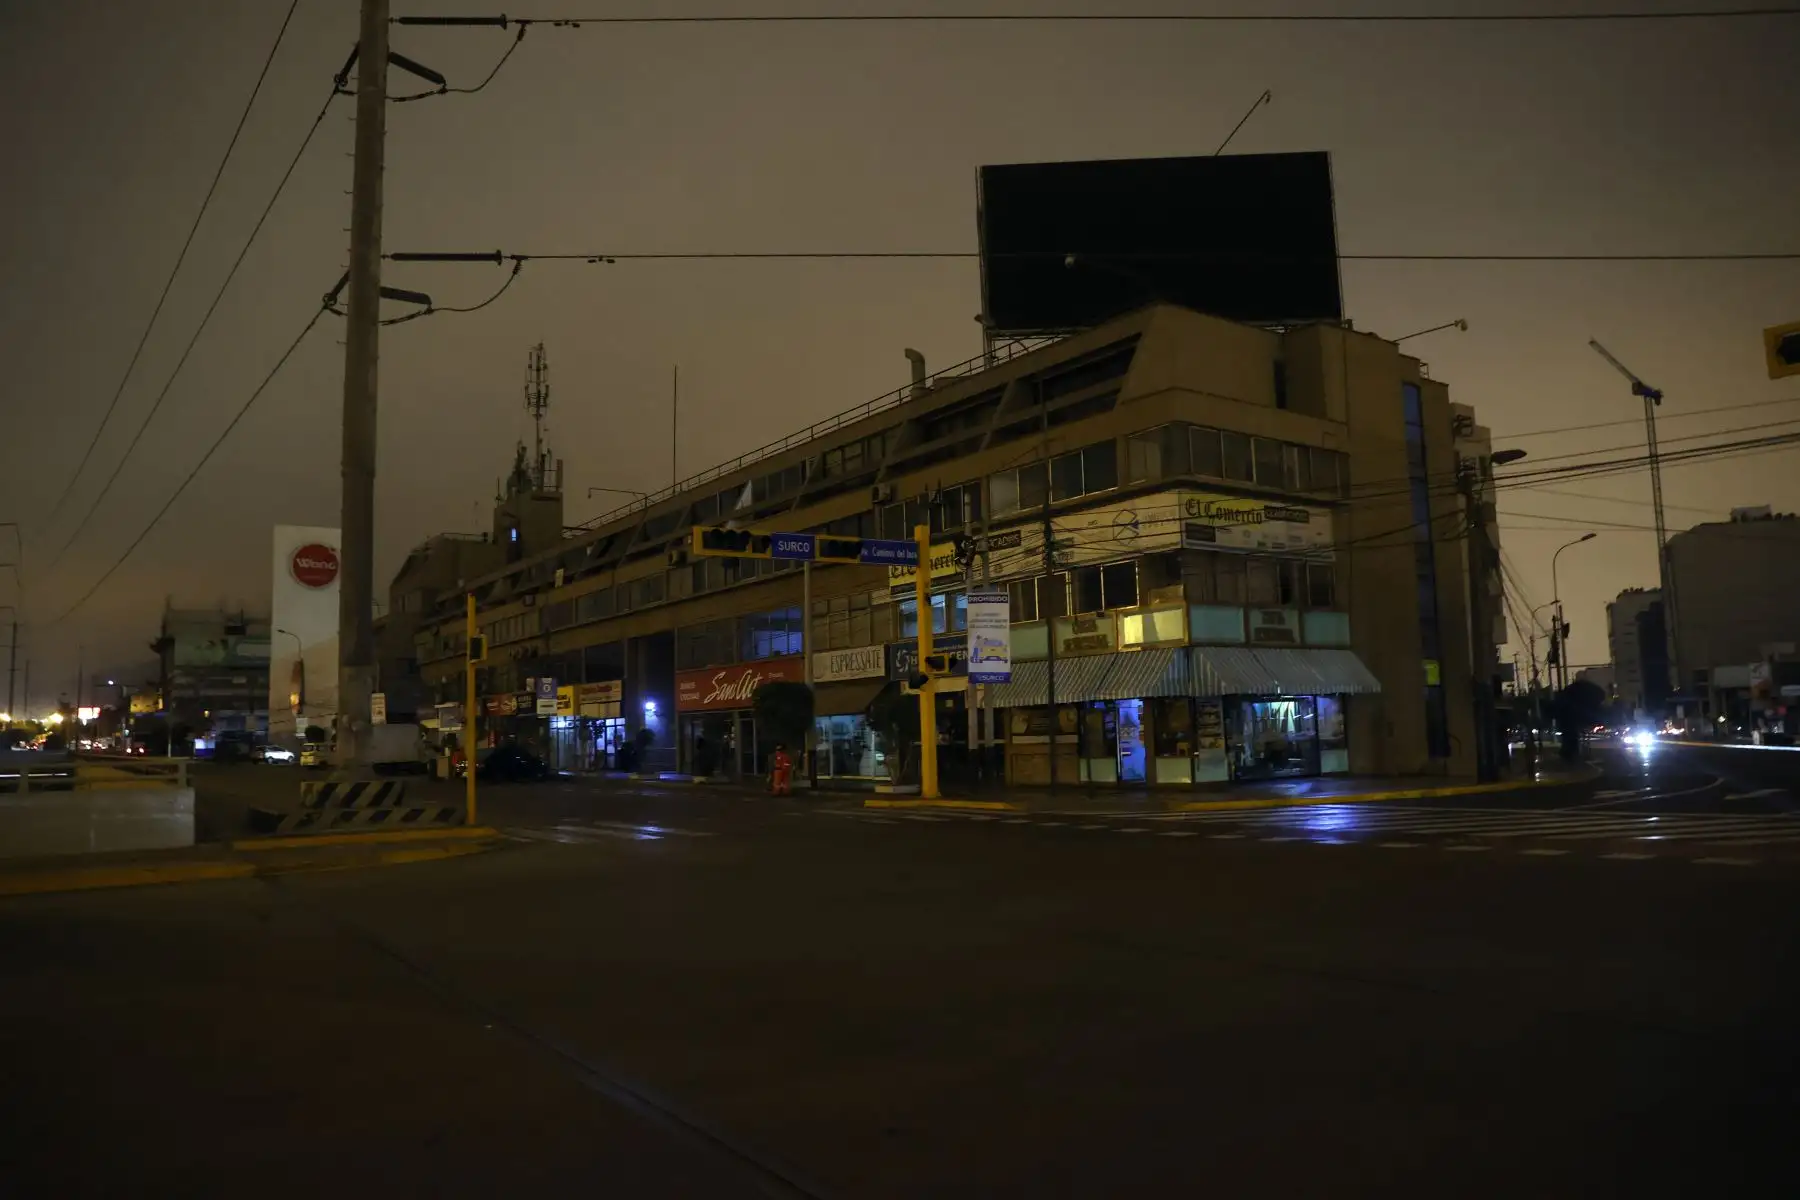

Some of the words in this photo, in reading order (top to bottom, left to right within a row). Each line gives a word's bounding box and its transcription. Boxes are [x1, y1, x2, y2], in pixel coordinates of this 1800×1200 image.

[1185, 498, 1201, 518] El
[1204, 502, 1262, 526] Comercio
[777, 540, 811, 553] SURCO
[969, 595, 1008, 604] PROHIBIDO
[831, 649, 881, 674] ESPRESSATE
